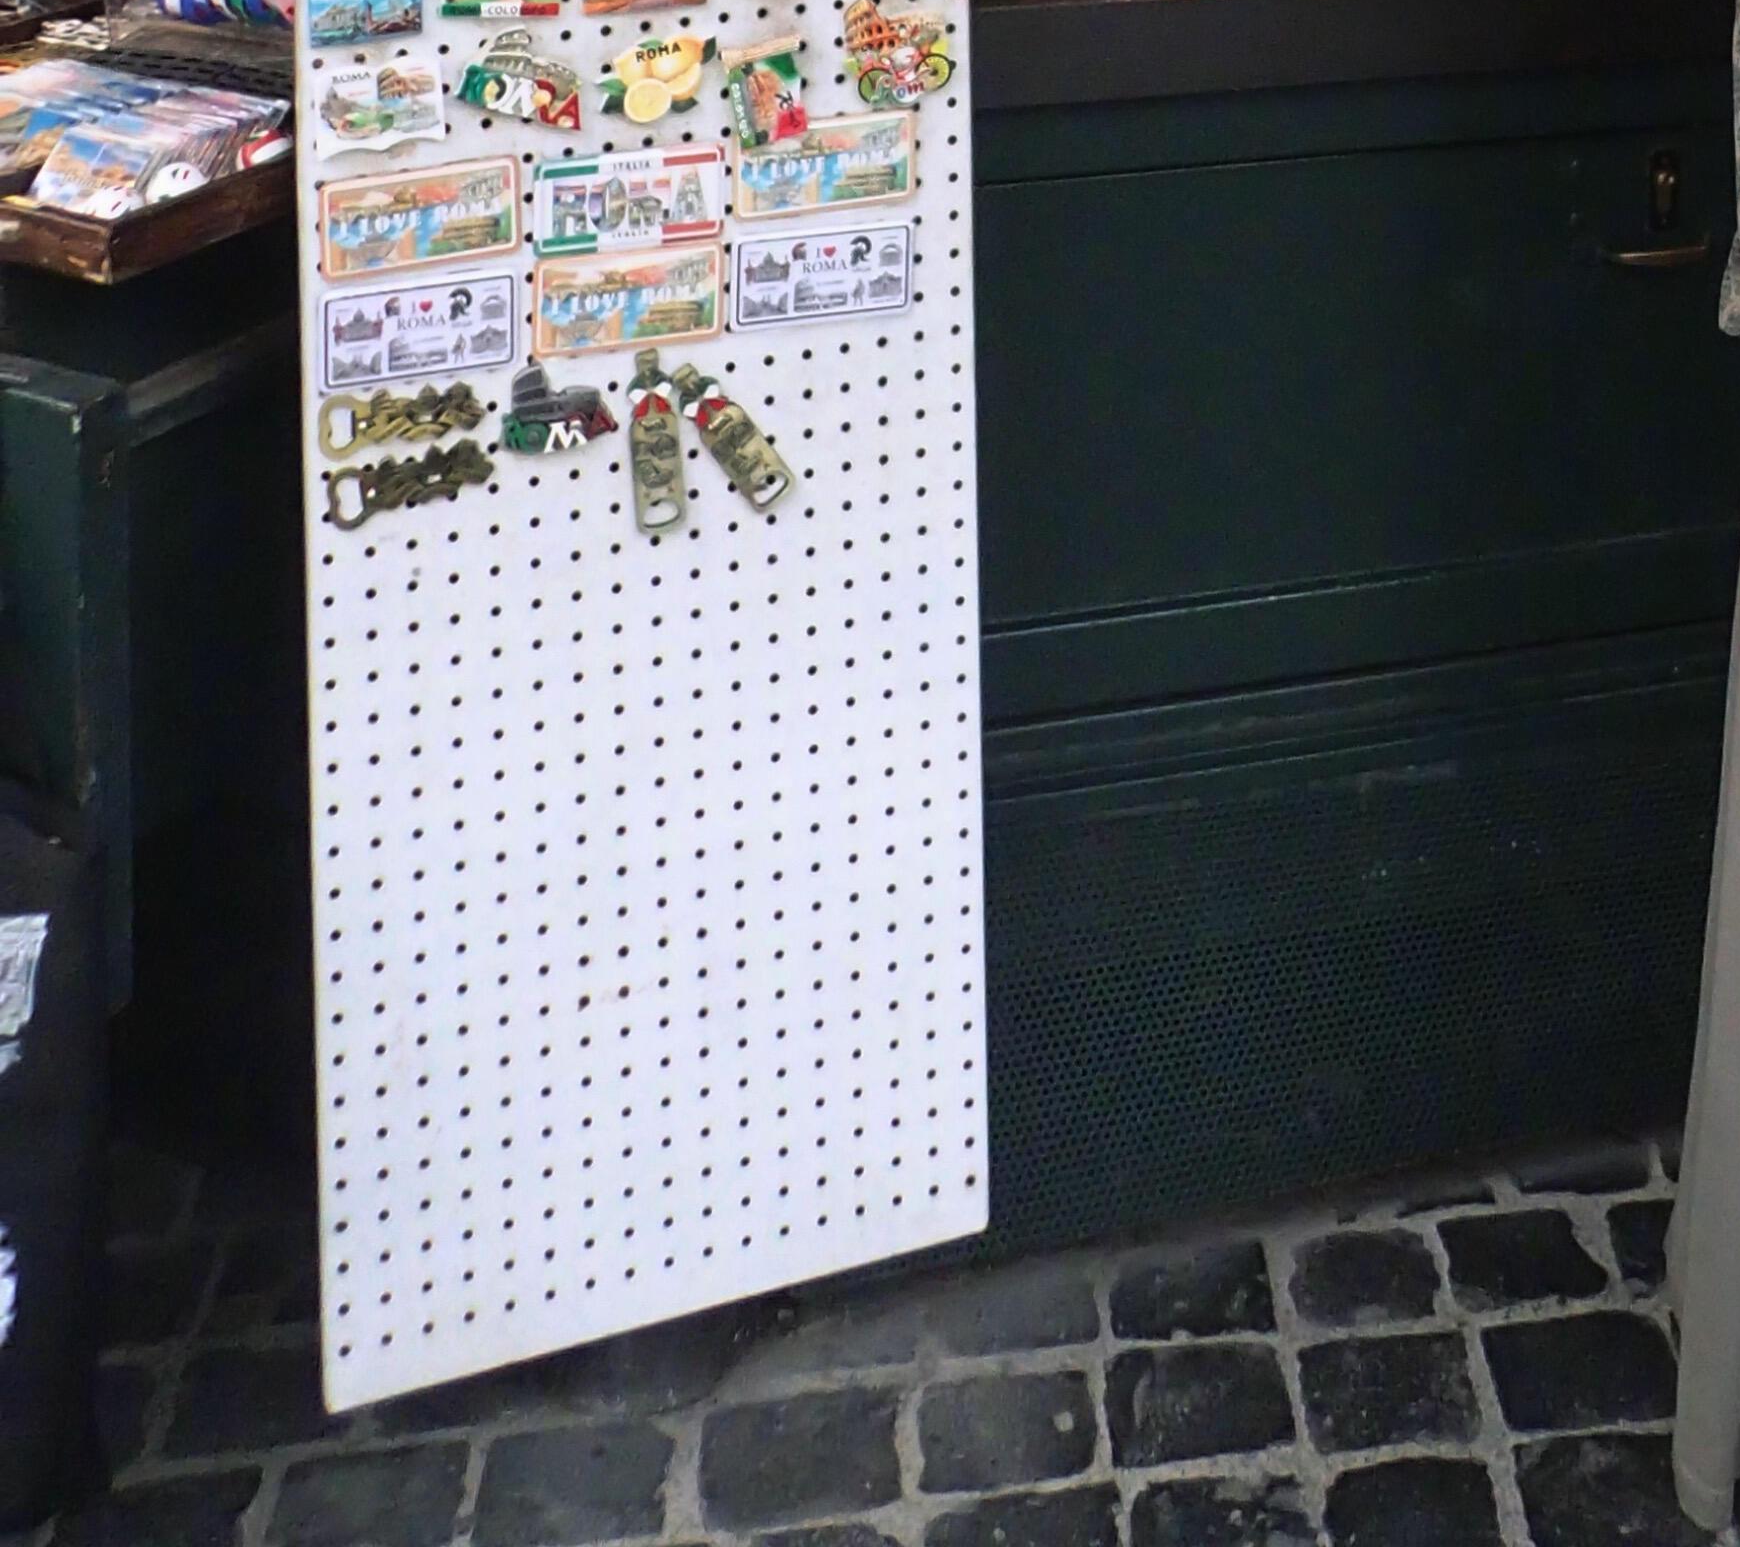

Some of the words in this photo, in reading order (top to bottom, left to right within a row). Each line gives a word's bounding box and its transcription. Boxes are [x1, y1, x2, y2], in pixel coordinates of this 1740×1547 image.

[634, 41, 682, 64] ROMA
[802, 258, 849, 274] ROMA
[395, 314, 448, 332] ROMA
